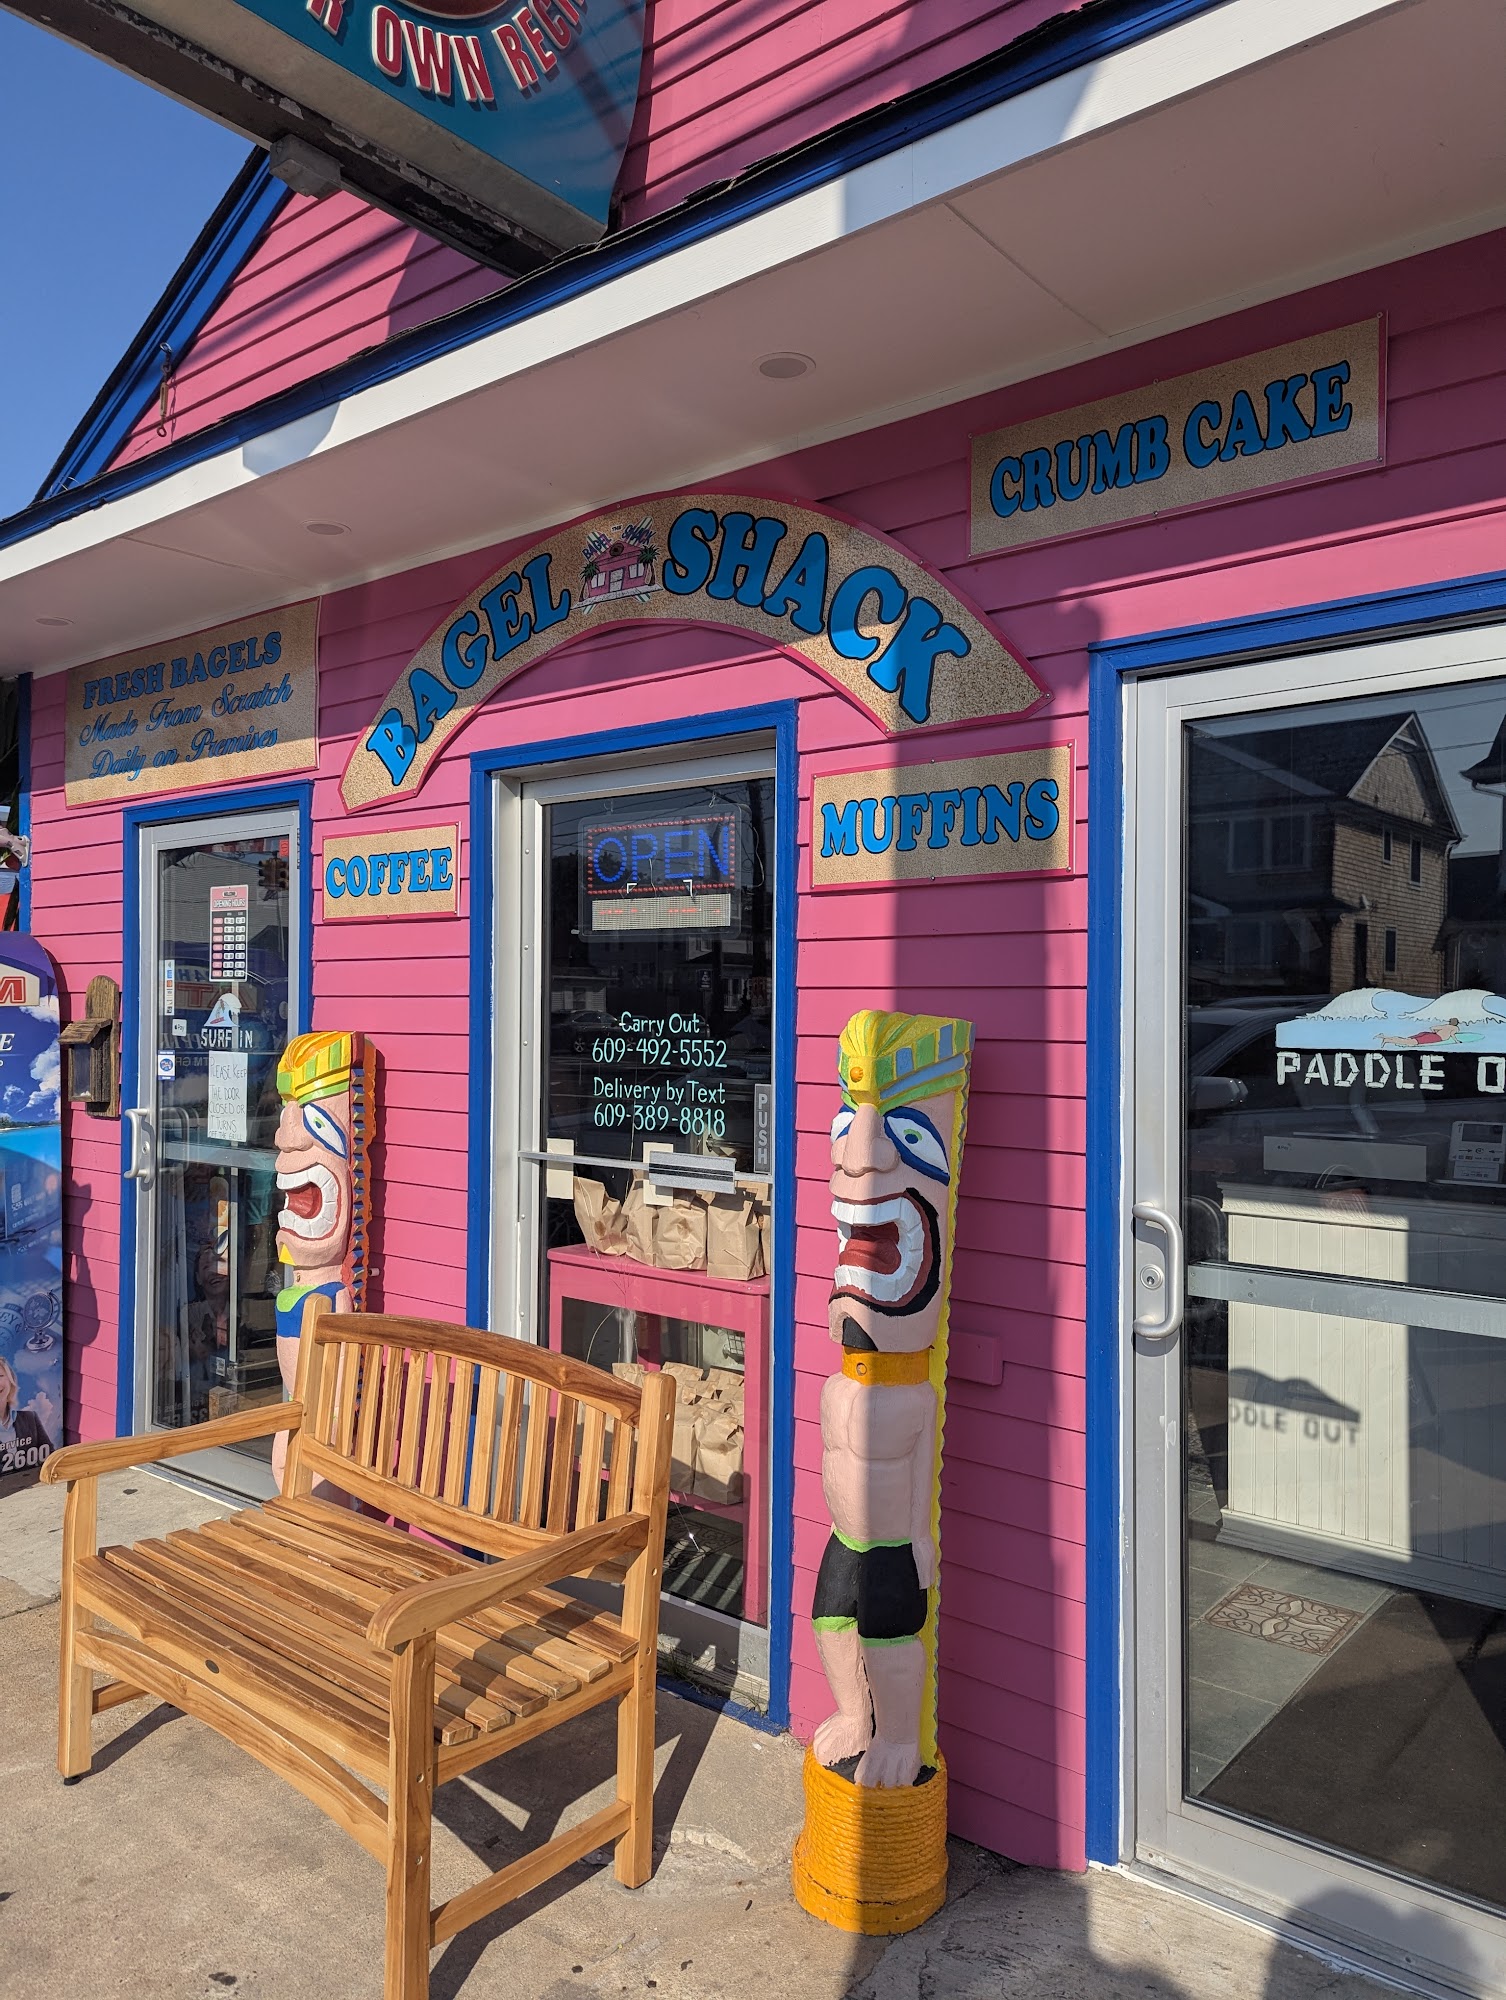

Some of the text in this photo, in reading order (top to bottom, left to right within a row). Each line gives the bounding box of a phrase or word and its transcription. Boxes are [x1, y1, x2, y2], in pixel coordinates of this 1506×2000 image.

[372, 4, 495, 102] OWN
[491, 0, 585, 90] REC
[990, 360, 1352, 518] CRUMB CAKE
[582, 533, 613, 560] BAGEL
[621, 524, 656, 545] SHACK
[366, 508, 971, 787] BAGEL SHACK
[83, 631, 282, 710] FRESH BAGELS
[80, 672, 294, 747] Made From Scratch
[89, 725, 279, 781] Daily on Premises
[820, 778, 1060, 858] MUFFINS
[325, 846, 454, 899] COFFEE
[593, 825, 731, 883] OPEN
[201, 1028, 233, 1049] SURF
[239, 1030, 253, 1049] IN
[619, 1011, 700, 1037] Carry Out
[209, 1056, 232, 1080] PLEASE
[592, 1037, 728, 1068] 609-492-5552
[1276, 1051, 1446, 1091] PADDLE
[208, 1101, 235, 1115] CLOSED
[209, 1085, 240, 1101] THE DOOR
[593, 1076, 726, 1105] Delivery by Text
[594, 1103, 726, 1137] 609-389-8818
[757, 1093, 768, 1165] PUSH
[2, 1444, 50, 1471] 2600
